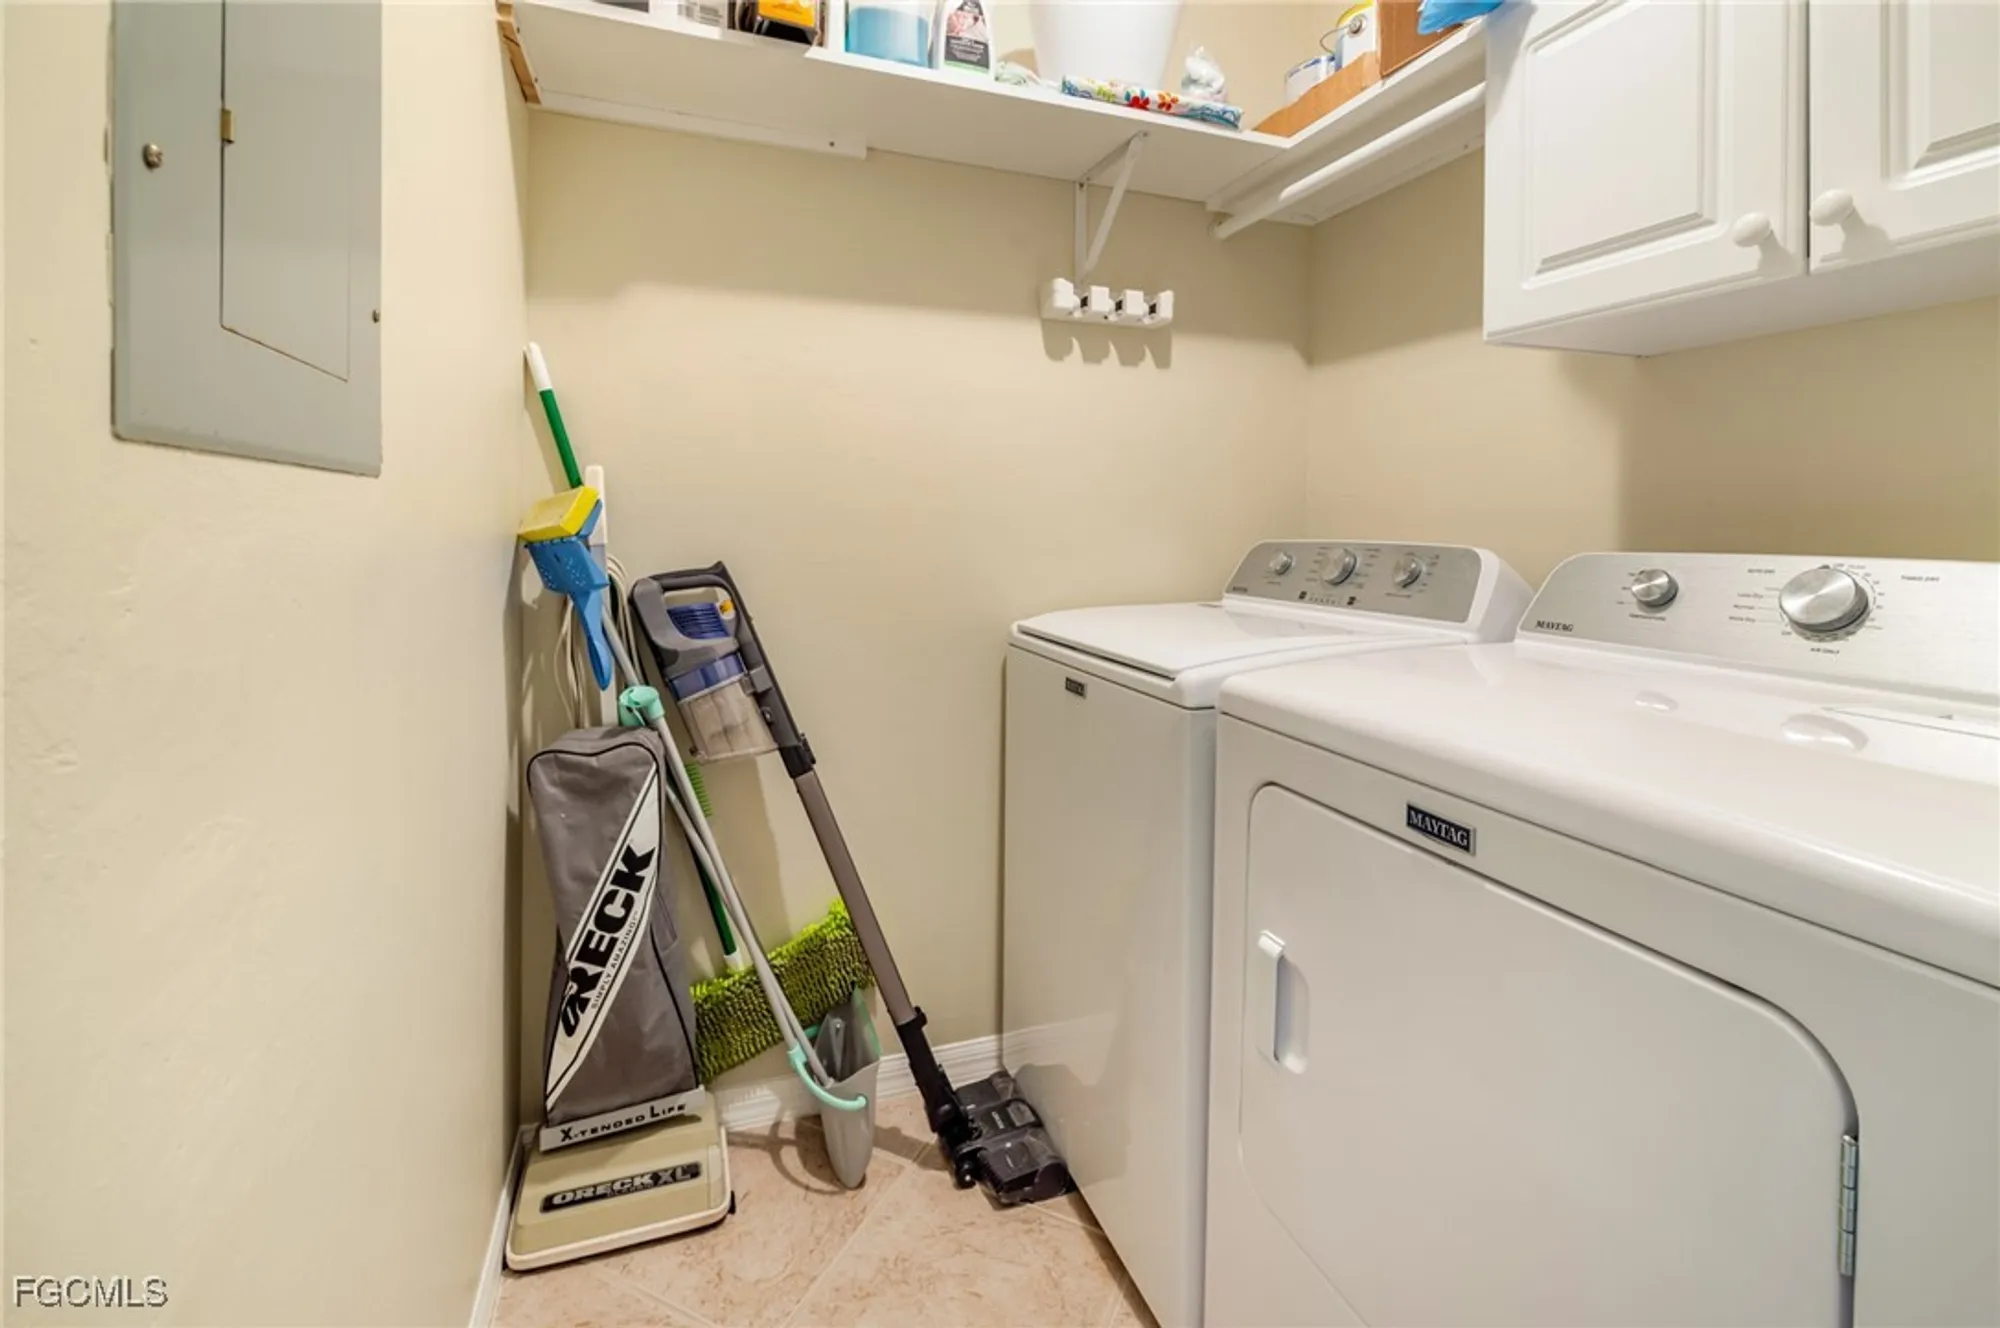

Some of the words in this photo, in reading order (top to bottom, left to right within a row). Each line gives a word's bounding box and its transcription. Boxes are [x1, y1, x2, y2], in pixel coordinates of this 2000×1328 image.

[1409, 809, 1468, 847] MAYTAG
[560, 844, 656, 1038] ORECK
[591, 972, 612, 1009] SIMPLY
[551, 1173, 654, 1205] ORECK
[657, 1165, 693, 1186] XL
